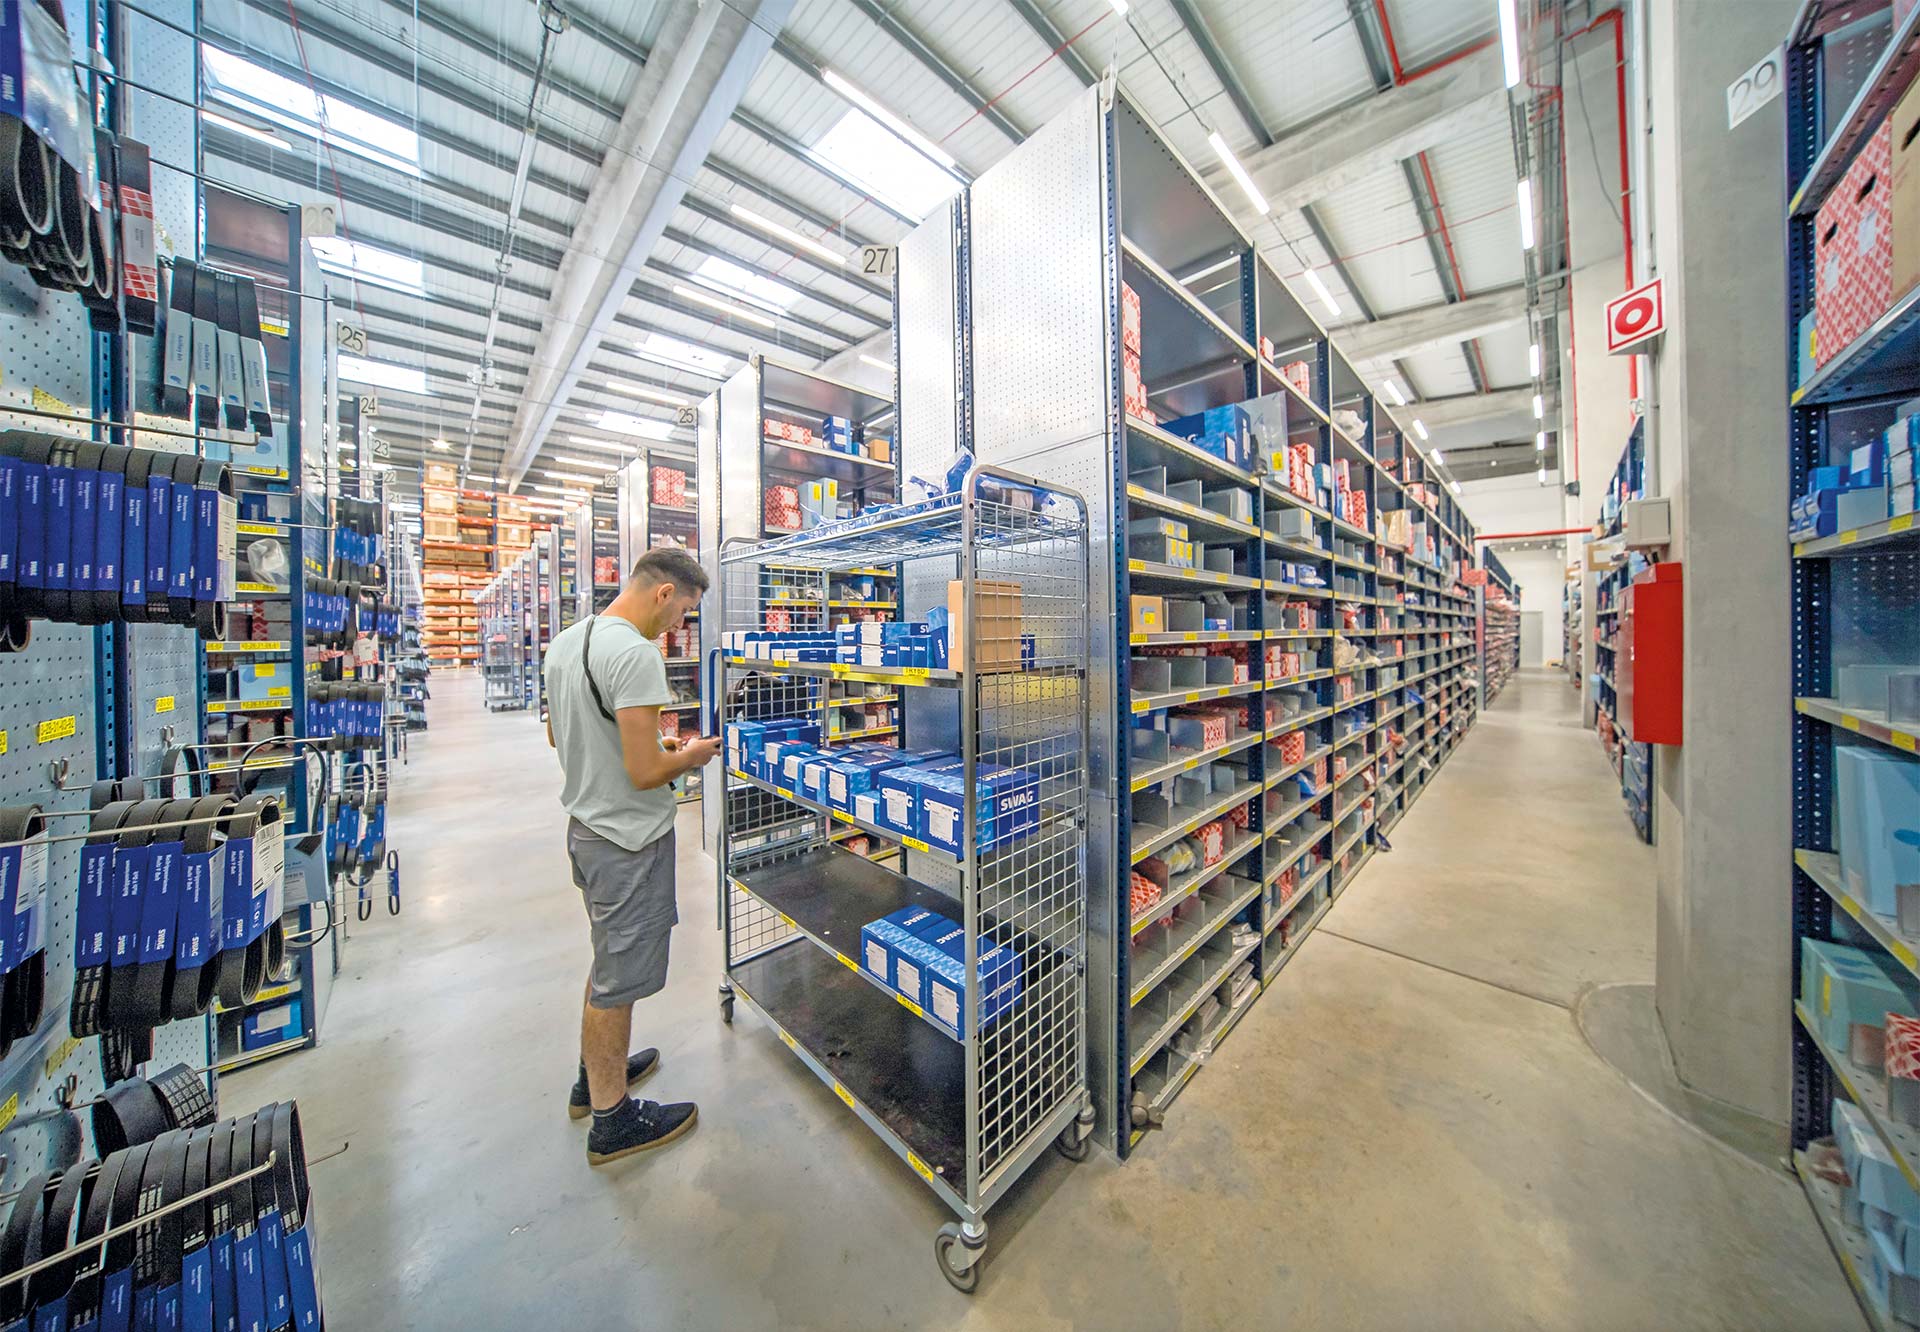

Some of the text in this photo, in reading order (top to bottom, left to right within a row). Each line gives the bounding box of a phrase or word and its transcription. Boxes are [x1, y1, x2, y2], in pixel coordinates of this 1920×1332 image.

[1731, 59, 1777, 122] 29
[864, 248, 889, 273] 27
[341, 325, 364, 352] 25
[360, 397, 376, 414] 24
[679, 407, 694, 424] 25
[373, 439, 389, 456] 23
[384, 472, 397, 485] 22
[606, 474, 618, 487] 23
[881, 787, 915, 808] SG
[1000, 790, 1035, 812] SWAG
[923, 798, 960, 822] SG
[235, 918, 244, 938] SWAG
[903, 911, 931, 927] SWAG
[93, 932, 103, 954] SWAG
[156, 928, 167, 951] SWAG
[191, 936, 200, 957] SWAG
[936, 928, 965, 945] SWAG
